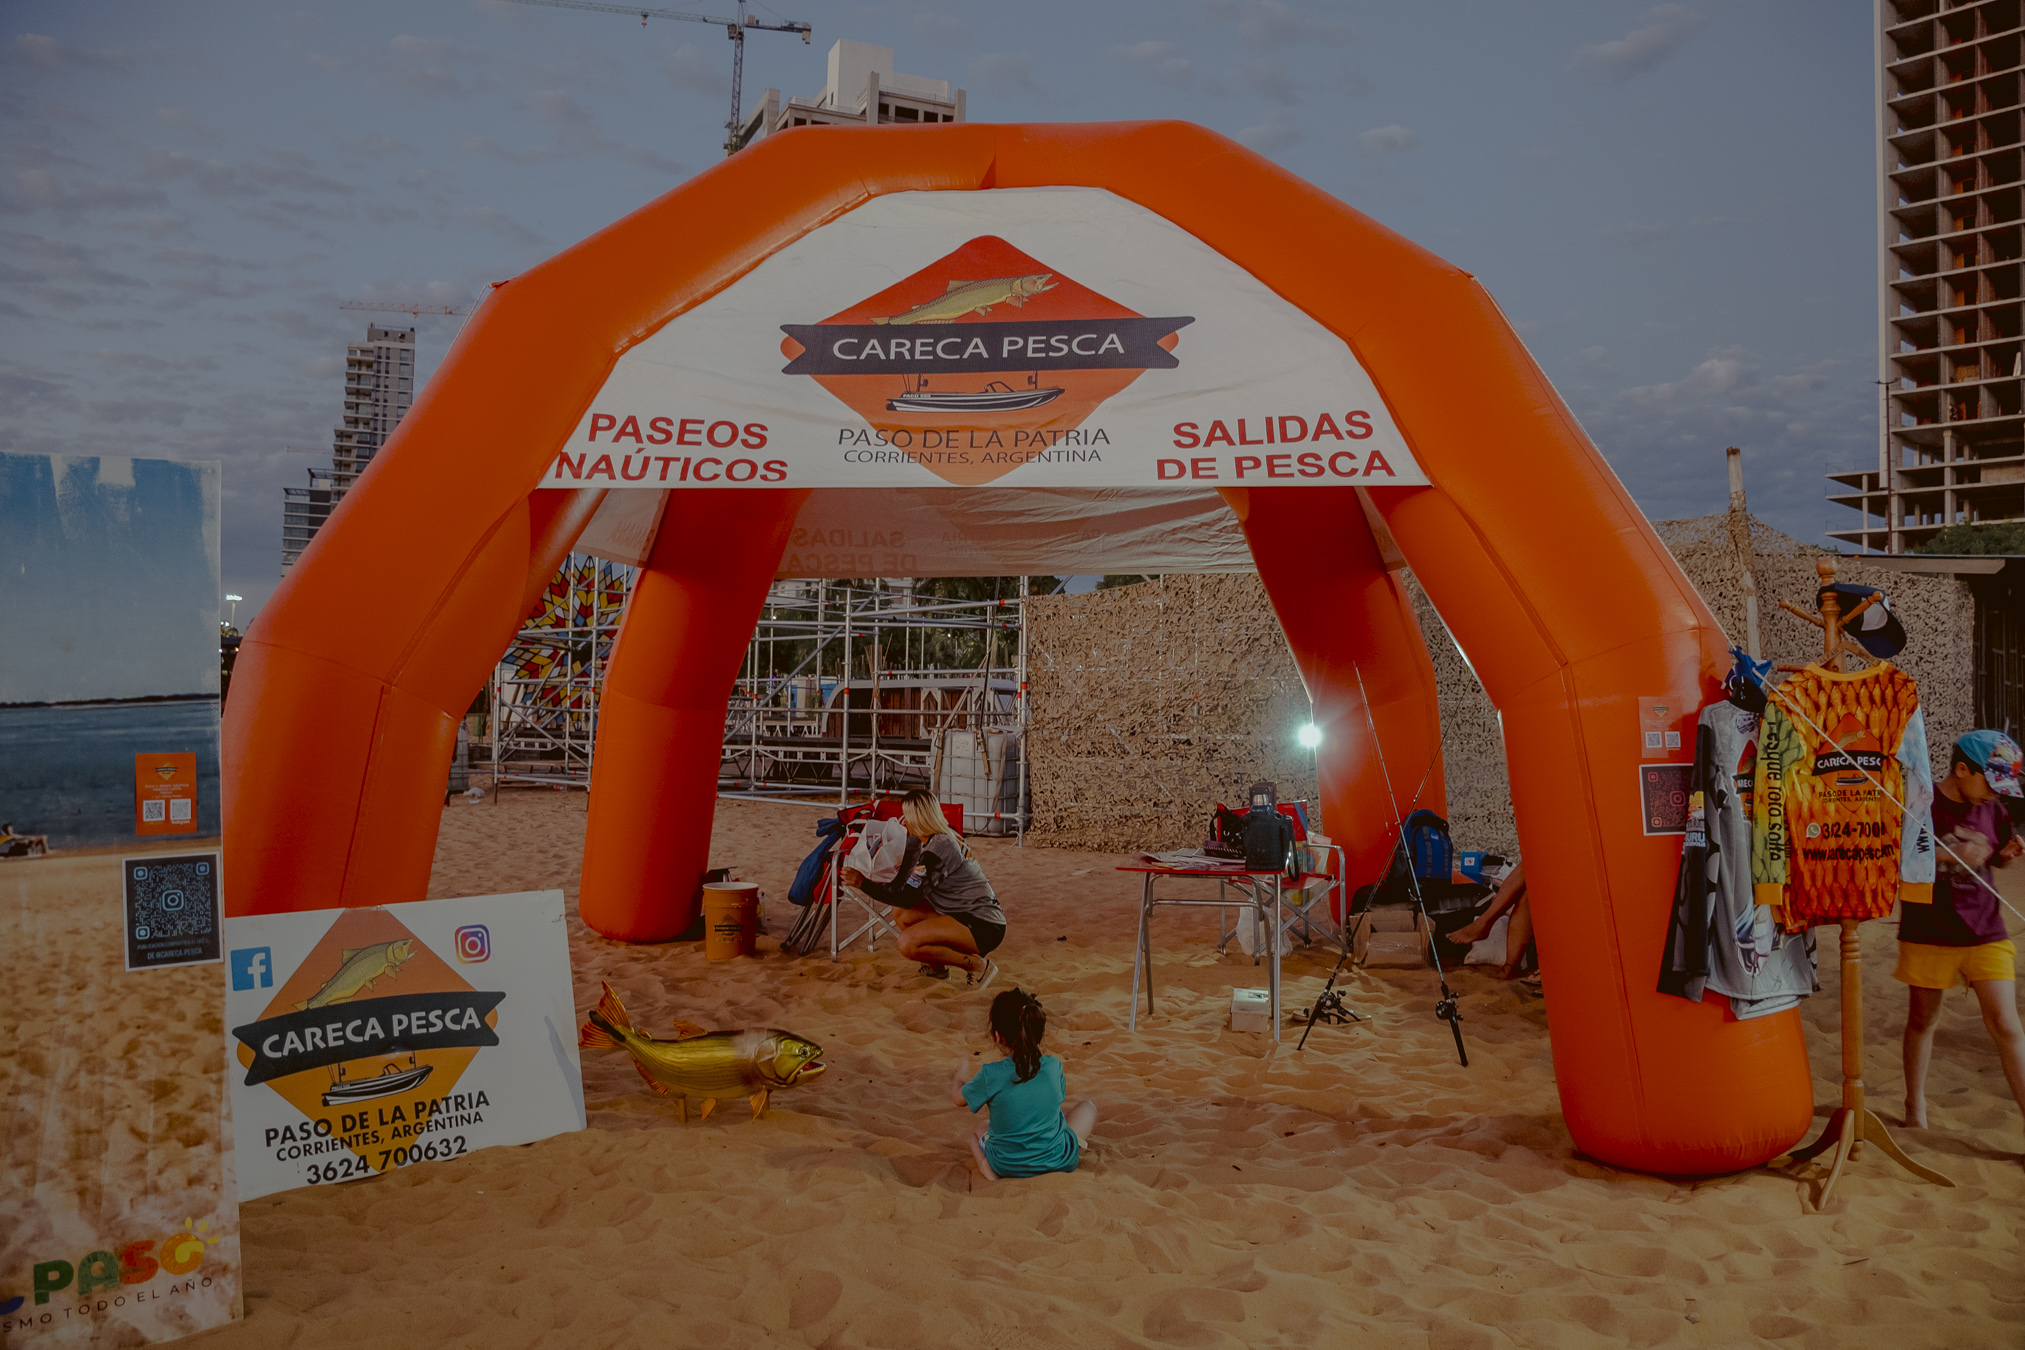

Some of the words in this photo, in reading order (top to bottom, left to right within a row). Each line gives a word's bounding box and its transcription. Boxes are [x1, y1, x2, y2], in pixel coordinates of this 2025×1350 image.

[832, 337, 989, 361] CARECA
[1002, 332, 1126, 358] PESCA
[588, 413, 769, 450] PASEOS
[838, 428, 913, 448] PASO
[922, 429, 960, 449] DE
[969, 430, 1004, 449] LA
[1014, 428, 1111, 449] PATRIA
[1172, 410, 1374, 449] SALIDAS
[554, 447, 789, 482] NAÚTICOS
[844, 450, 974, 466] CORRIENTES,
[980, 449, 1102, 464] ARGENTINA
[1156, 457, 1219, 481] DE
[1234, 450, 1397, 479] PESCA
[262, 1017, 384, 1059] CARECA
[392, 1007, 481, 1037] PESCA
[264, 1118, 333, 1147] PASO
[341, 1110, 370, 1134] DE
[378, 1103, 407, 1127] LA
[414, 1090, 491, 1120] PATRIA
[276, 1129, 385, 1161] CORRIENTES,
[391, 1111, 483, 1140] ARGENTINA
[306, 1154, 370, 1185] 3624
[378, 1135, 468, 1171] 700632
[33, 1232, 205, 1306] PASO
[63, 1296, 126, 1319] TODO
[137, 1289, 160, 1303] EL
[169, 1277, 213, 1296] AÑO
